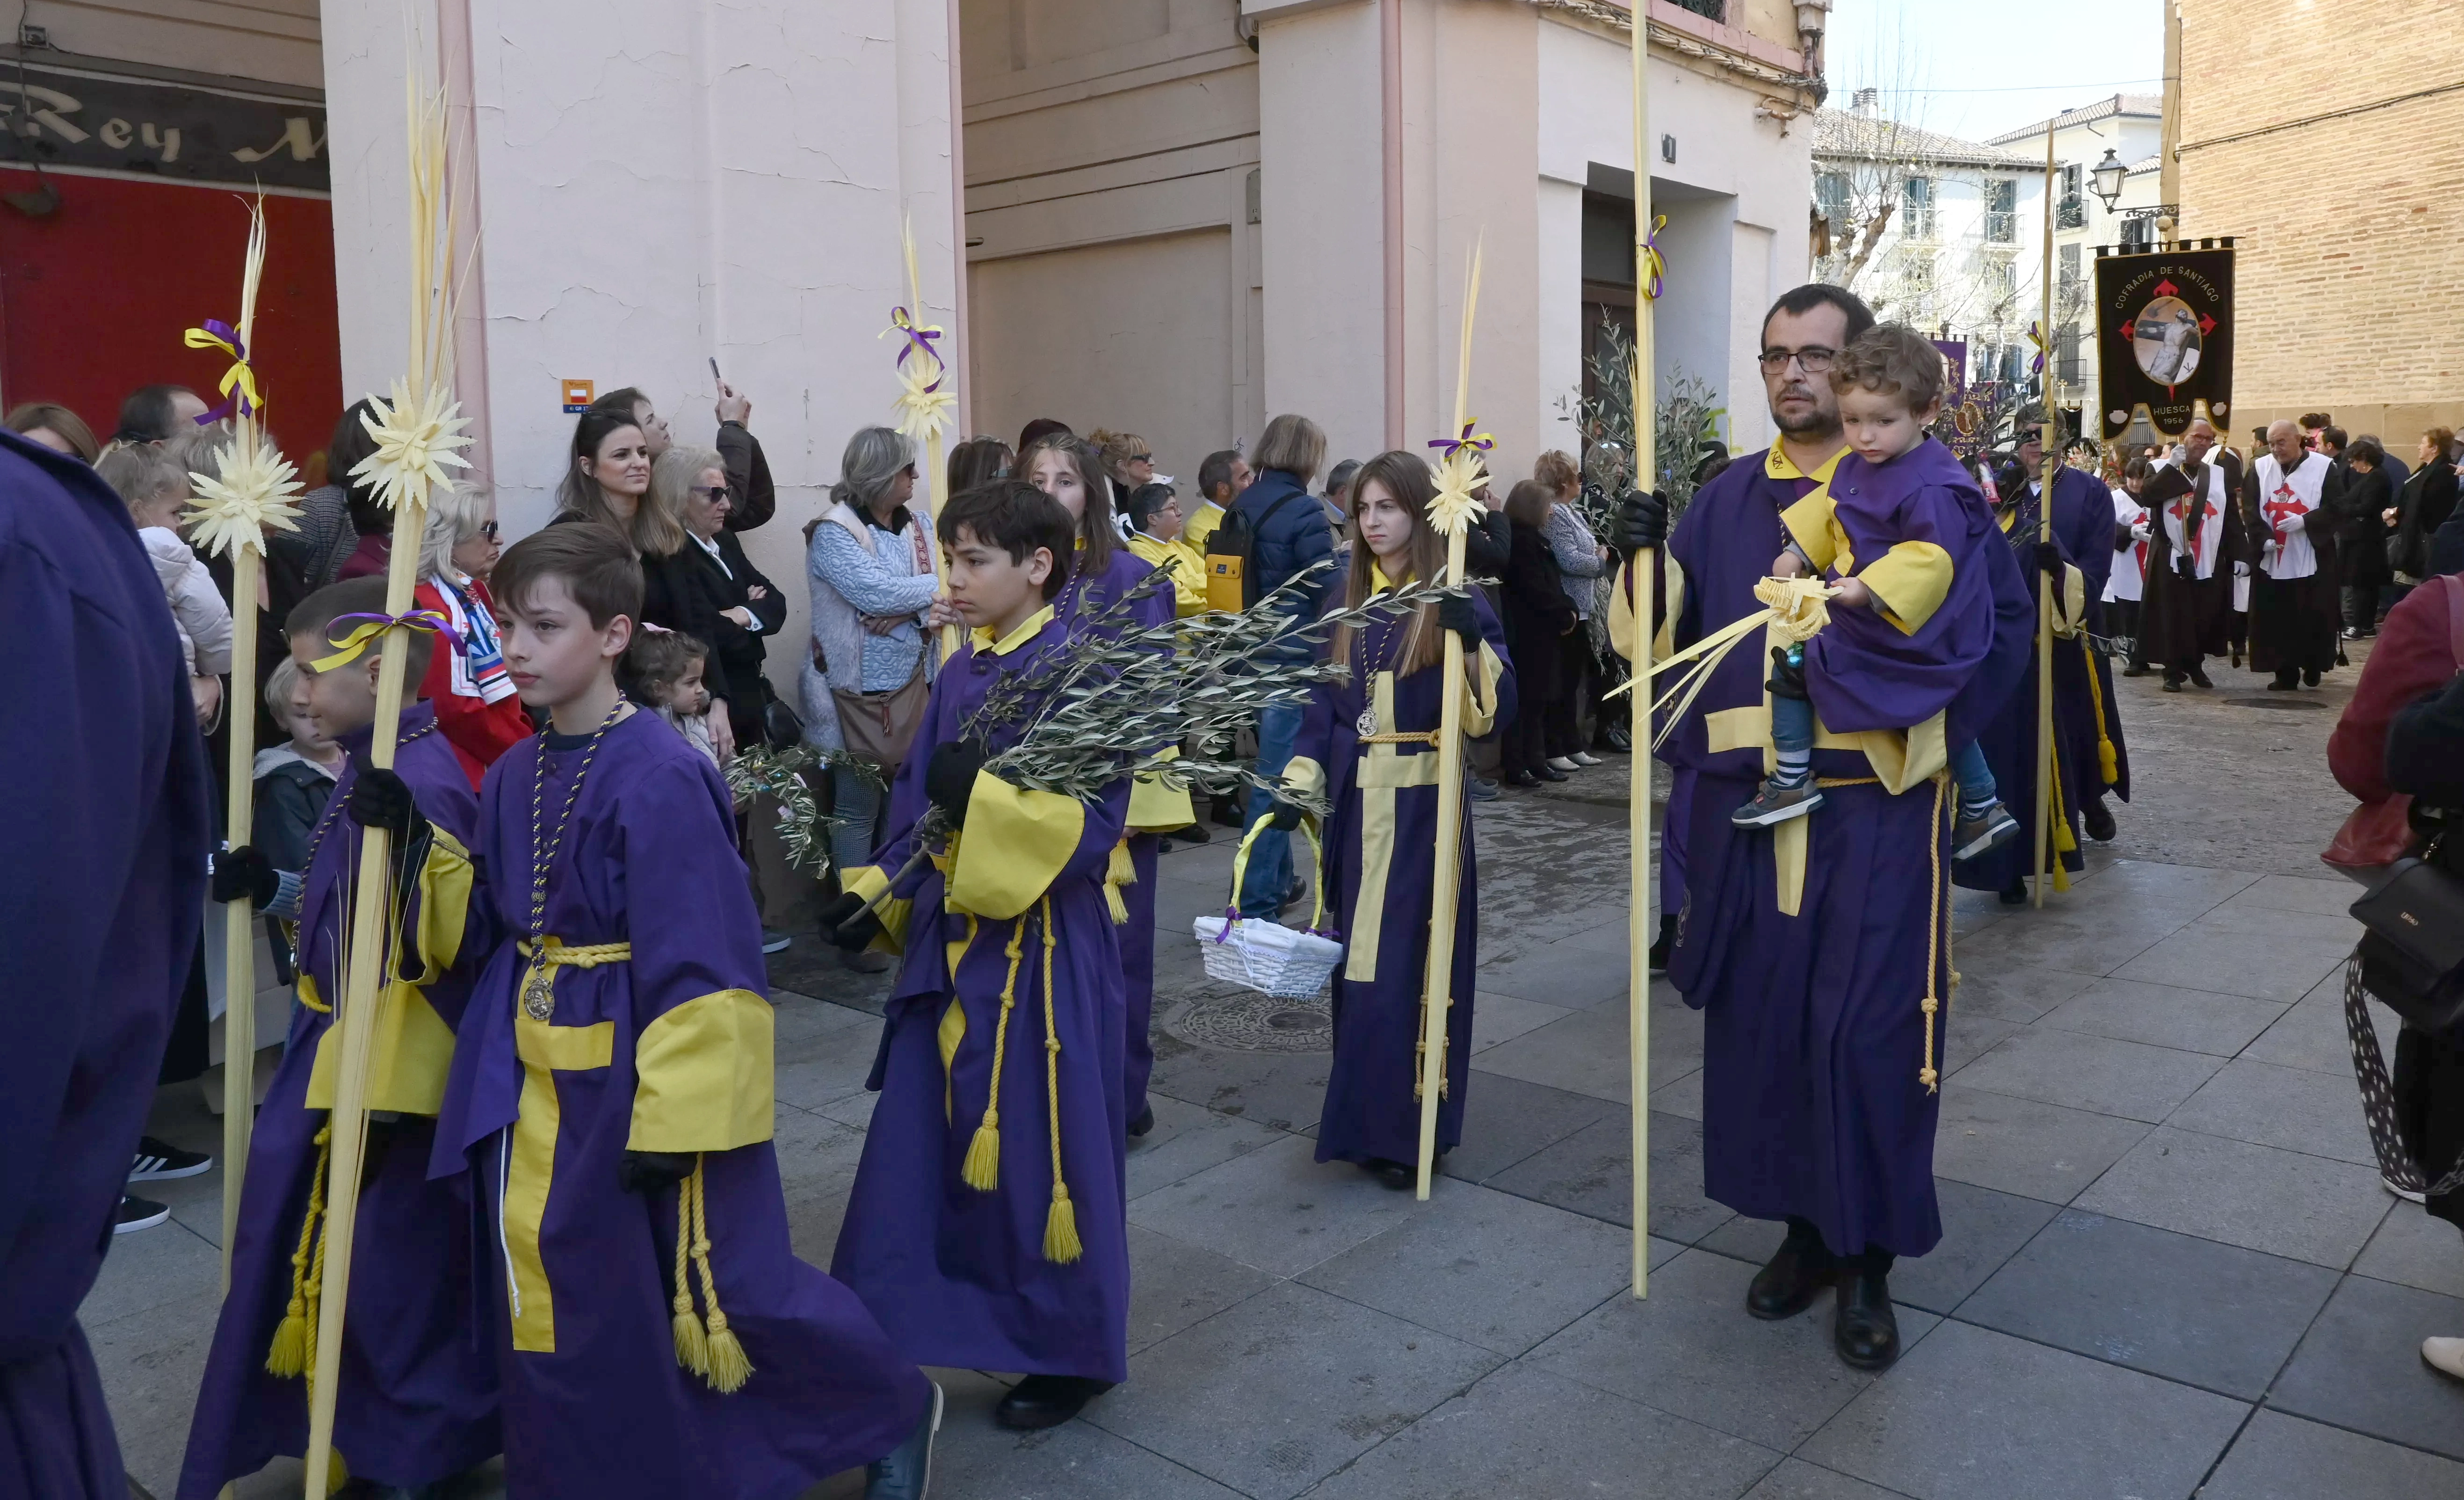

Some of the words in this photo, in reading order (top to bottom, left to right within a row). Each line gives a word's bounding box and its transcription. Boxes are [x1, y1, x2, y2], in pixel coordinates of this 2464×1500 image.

[0, 81, 181, 163] Rey
[1668, 139, 1673, 158] 1
[2115, 270, 2154, 309] COFRADIA
[2178, 266, 2219, 302] SANTIAGO
[2153, 405, 2191, 416] HUESCA
